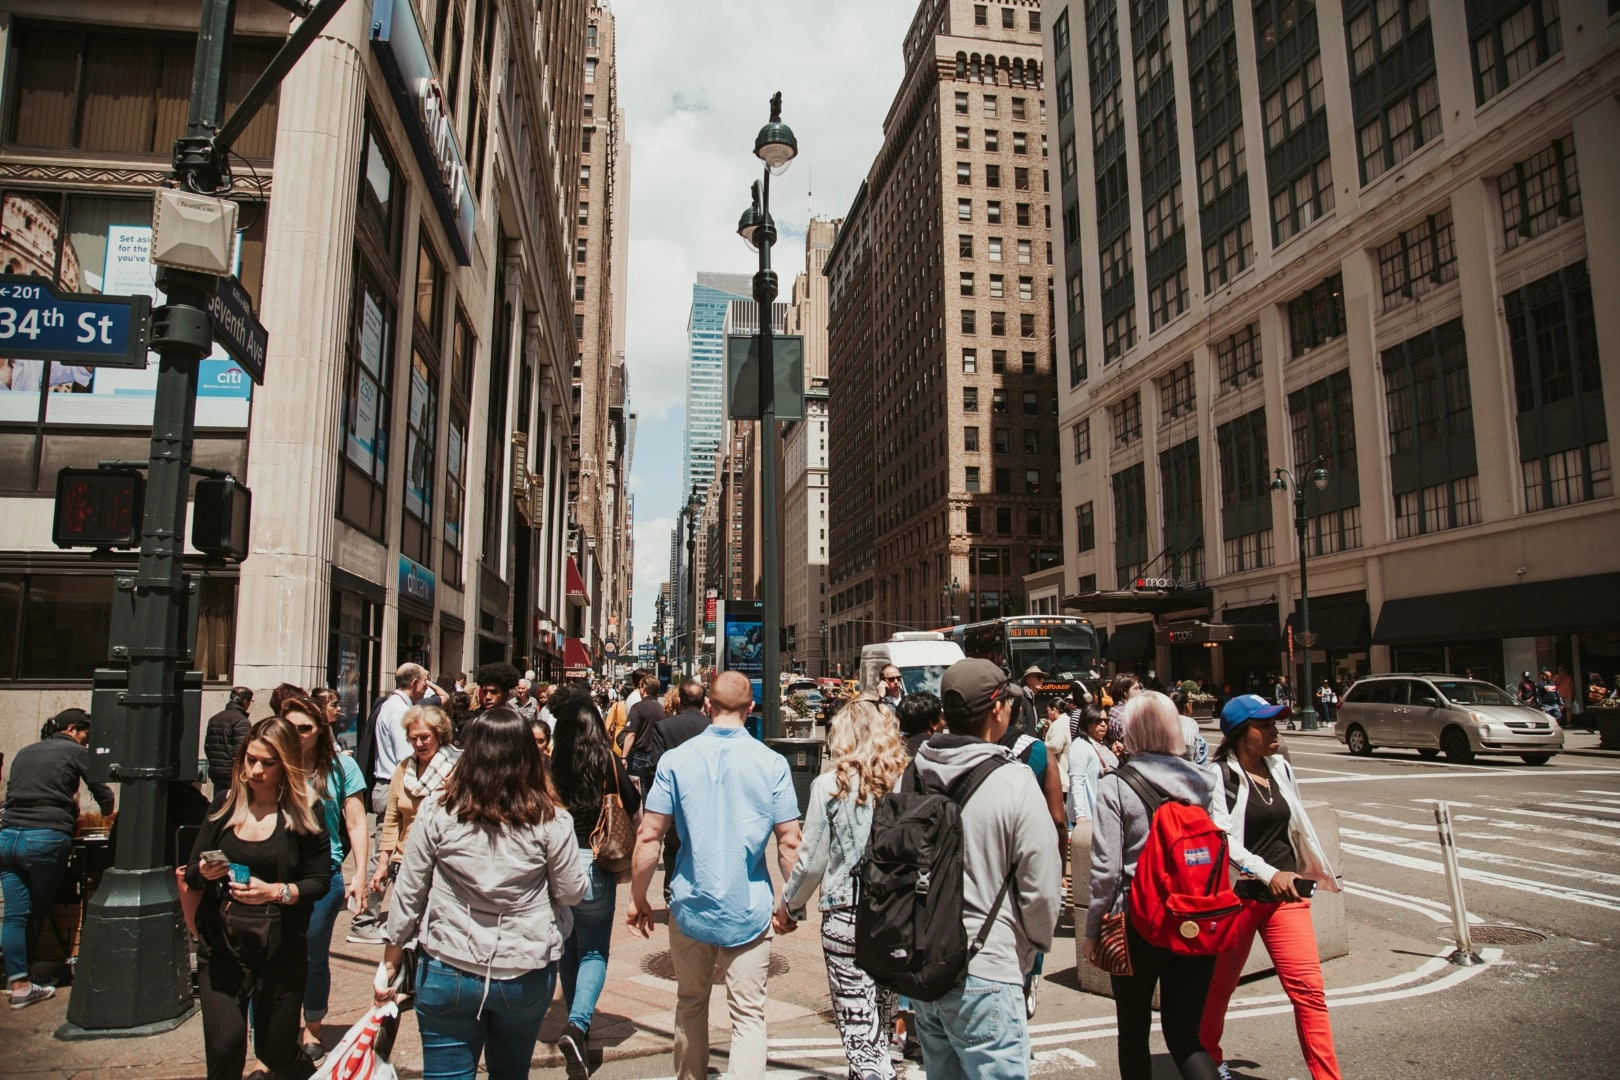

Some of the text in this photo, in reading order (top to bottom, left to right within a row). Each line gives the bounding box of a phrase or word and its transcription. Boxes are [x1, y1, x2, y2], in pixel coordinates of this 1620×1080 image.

[120, 235, 152, 243] Set asi
[118, 244, 148, 253] for the
[117, 255, 146, 263] you've
[12, 286, 40, 300] 201
[0, 306, 113, 344] 34th St
[207, 296, 246, 347] Seventh
[246, 330, 263, 366] Ave
[217, 369, 241, 384] citi
[1010, 628, 1048, 636] NEW YORK NY
